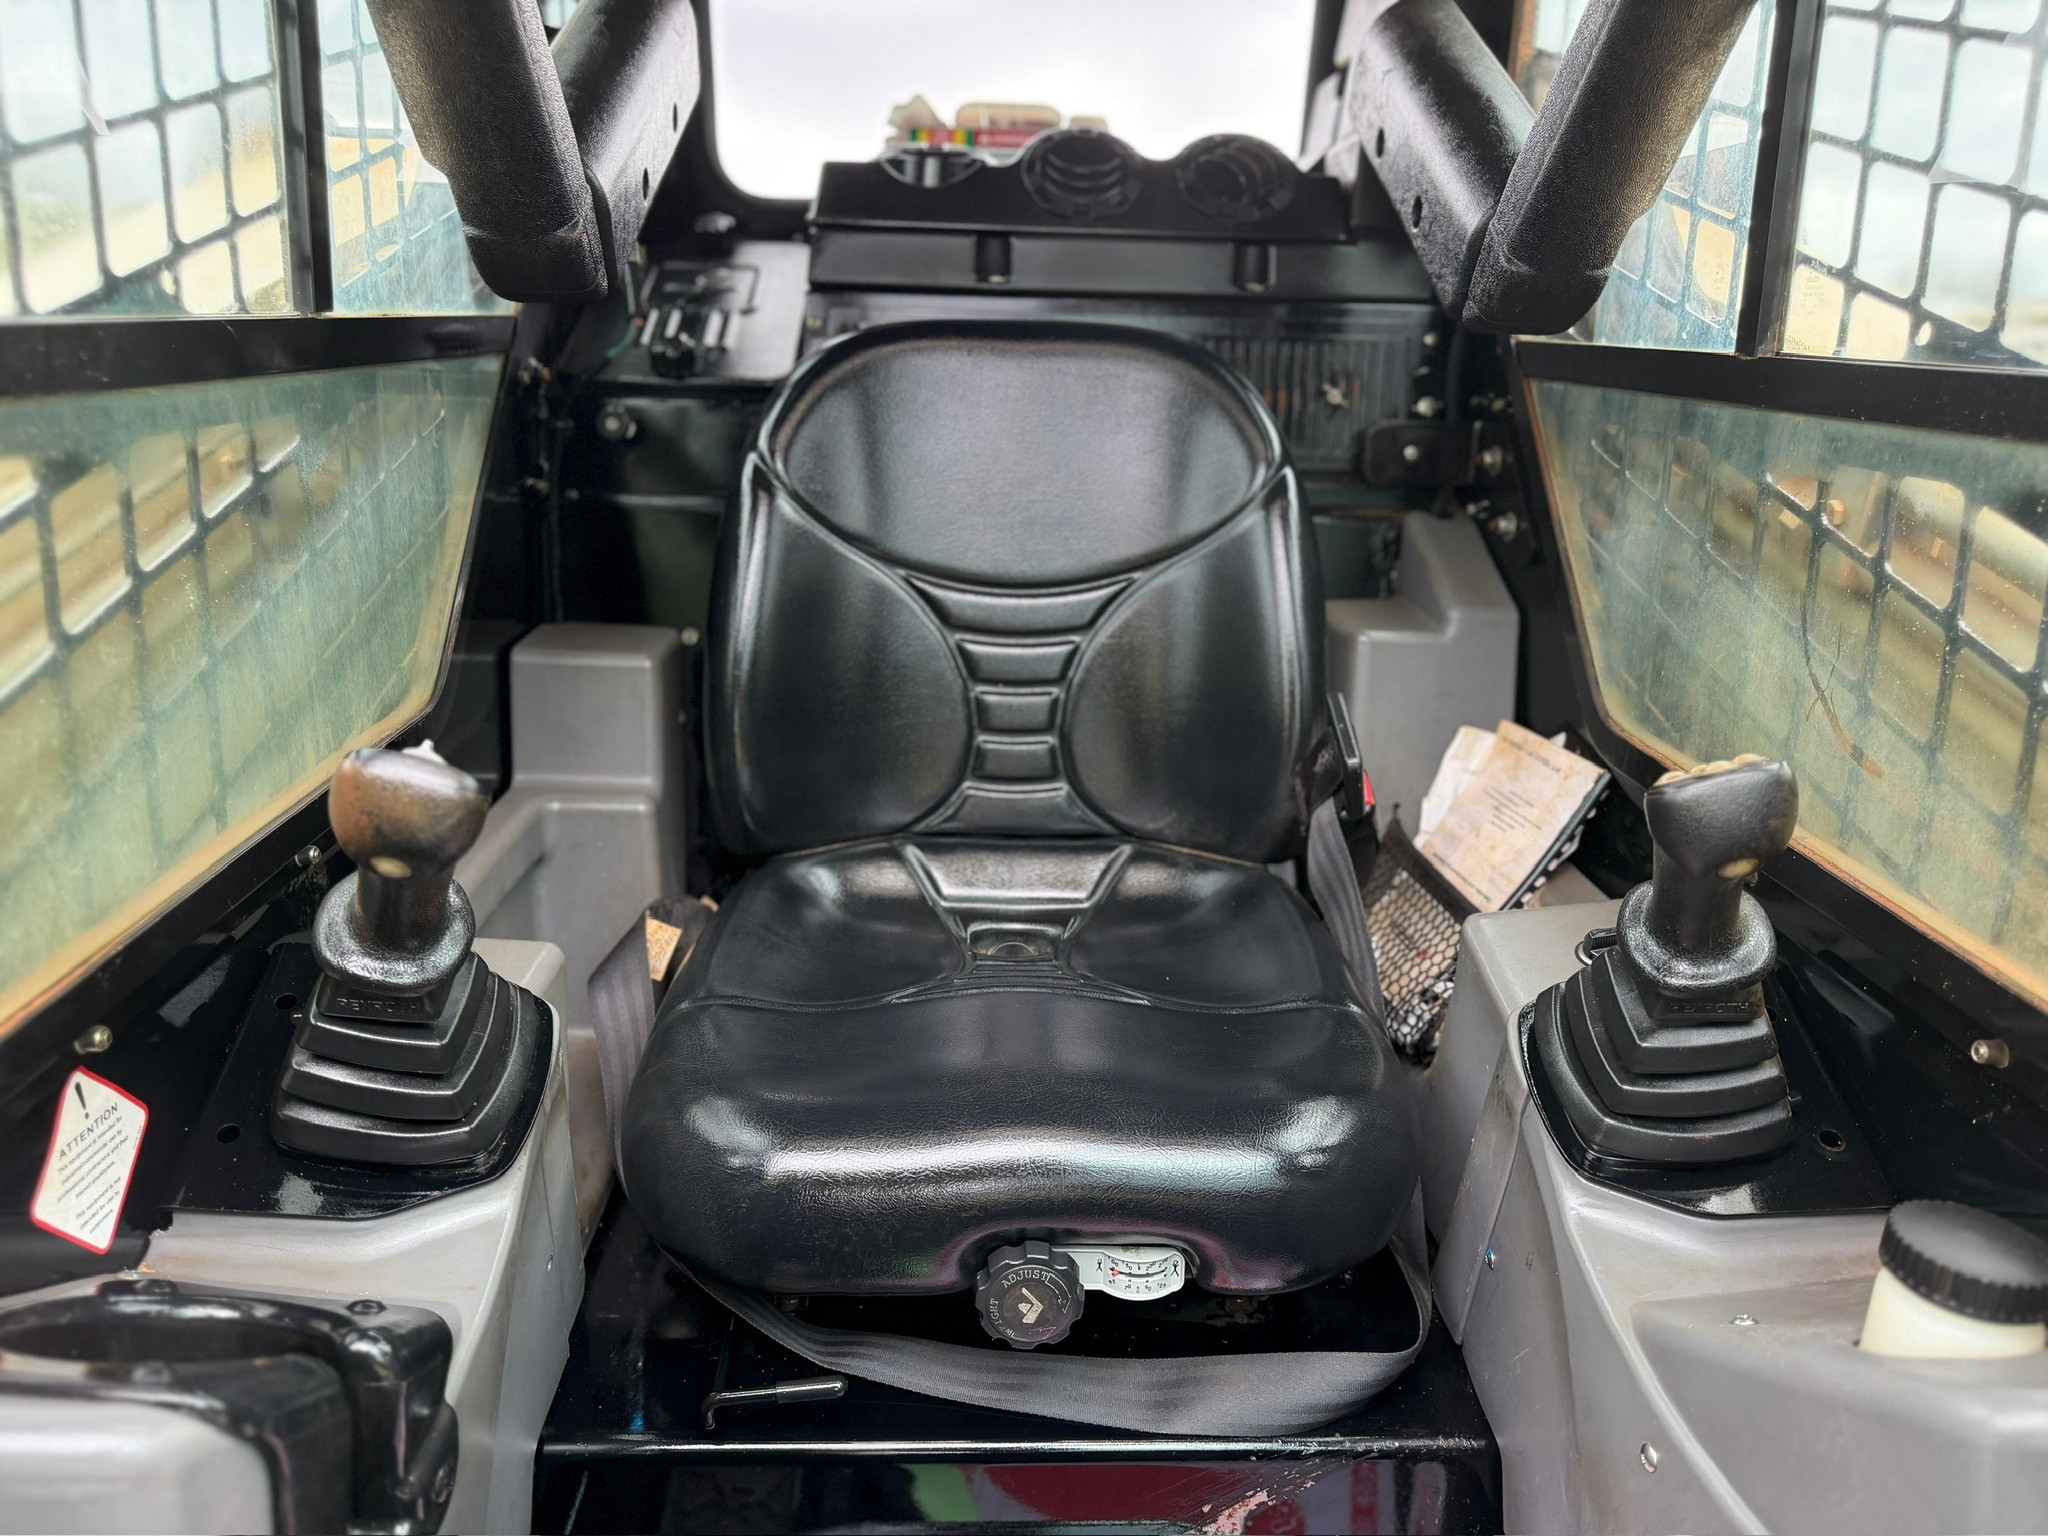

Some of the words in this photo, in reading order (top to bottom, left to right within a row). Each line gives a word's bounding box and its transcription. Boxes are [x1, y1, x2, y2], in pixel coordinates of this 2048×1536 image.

[58, 1163, 68, 1175] This
[69, 1142, 92, 1165] equipment
[97, 1120, 116, 1141] intended
[115, 1114, 123, 1125] for
[60, 1102, 119, 1161] ATTENTION
[108, 1134, 117, 1144] use
[58, 1173, 86, 1204] professional
[86, 1150, 111, 1178] contractors
[110, 1142, 120, 1154] and
[119, 1134, 129, 1147] their
[75, 1181, 92, 1199] trained
[75, 1209, 86, 1220] This
[86, 1186, 109, 1212] equipment
[113, 1175, 122, 1185] not
[80, 1208, 99, 1231] intended
[106, 1194, 115, 1205] use
[1001, 1269, 1050, 1289] ADJUST
[1123, 1283, 1132, 1291] 70
